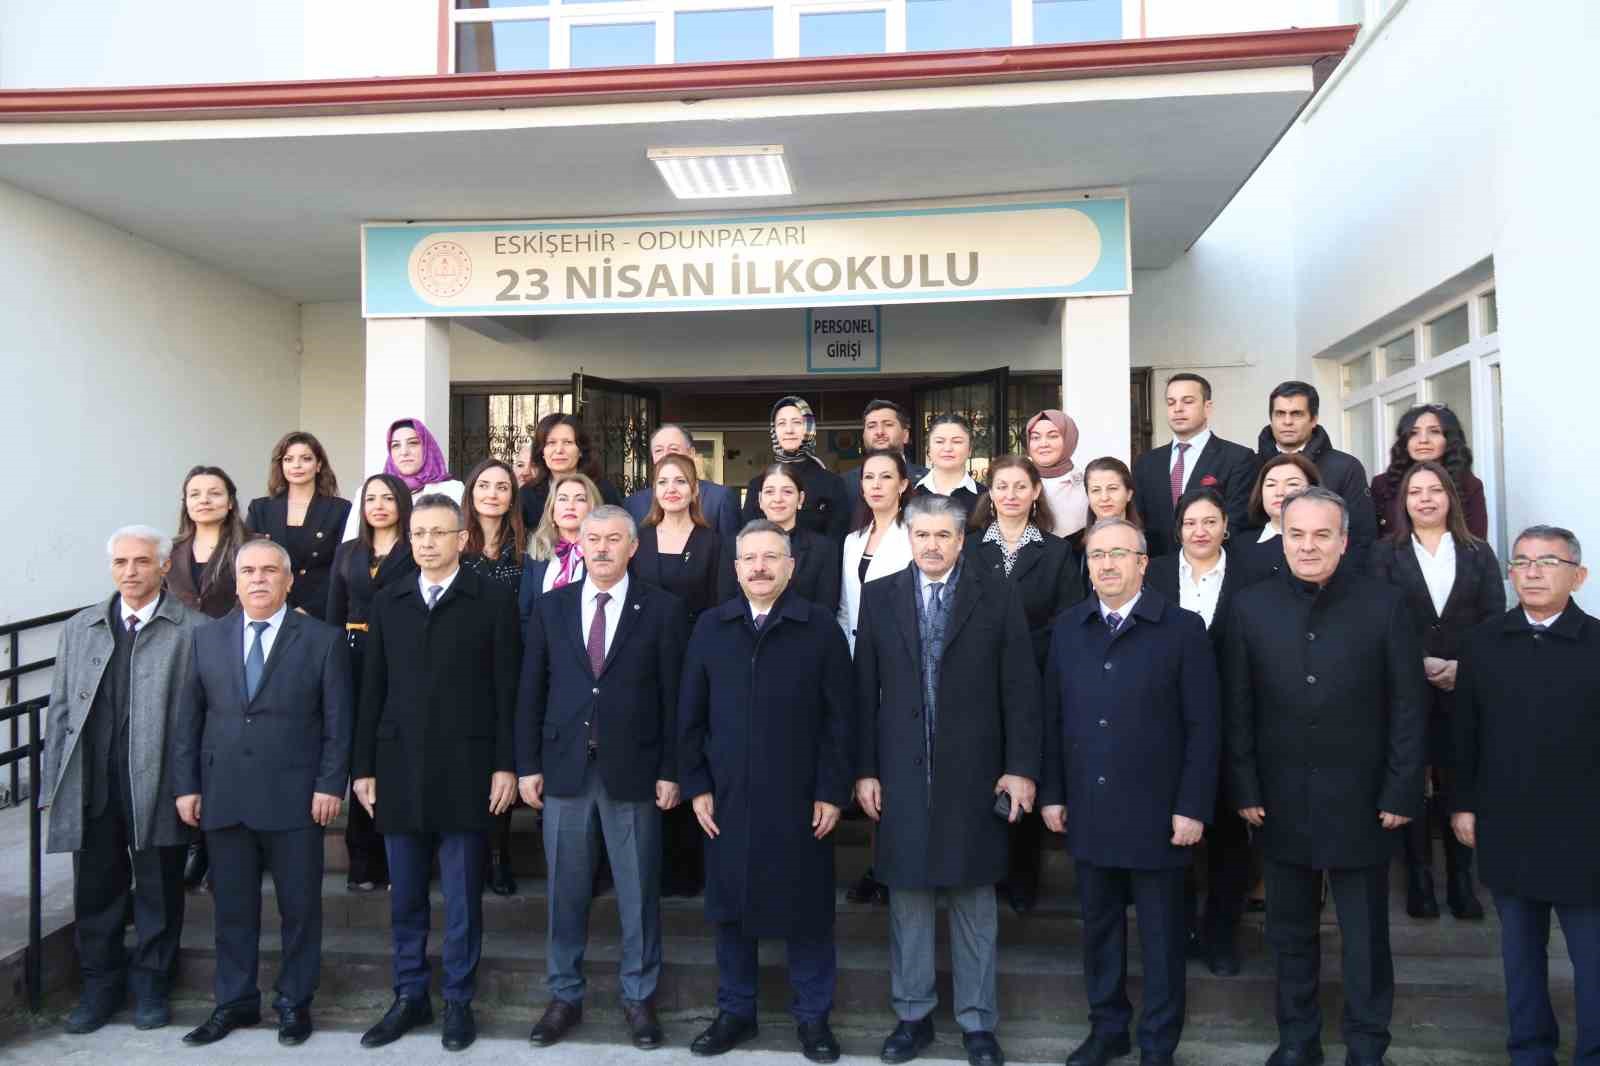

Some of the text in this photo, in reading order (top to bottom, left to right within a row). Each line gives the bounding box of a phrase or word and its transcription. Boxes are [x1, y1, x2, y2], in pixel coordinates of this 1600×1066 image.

[494, 229, 615, 257] ESKİŞEHİR
[638, 225, 806, 250] ODUNPAZARI
[495, 268, 550, 301] 23
[566, 257, 714, 299] NİSAN
[731, 251, 979, 295] İLKOKULU
[814, 320, 874, 334] PERSONEL
[827, 341, 861, 361] GİRİŞİ
